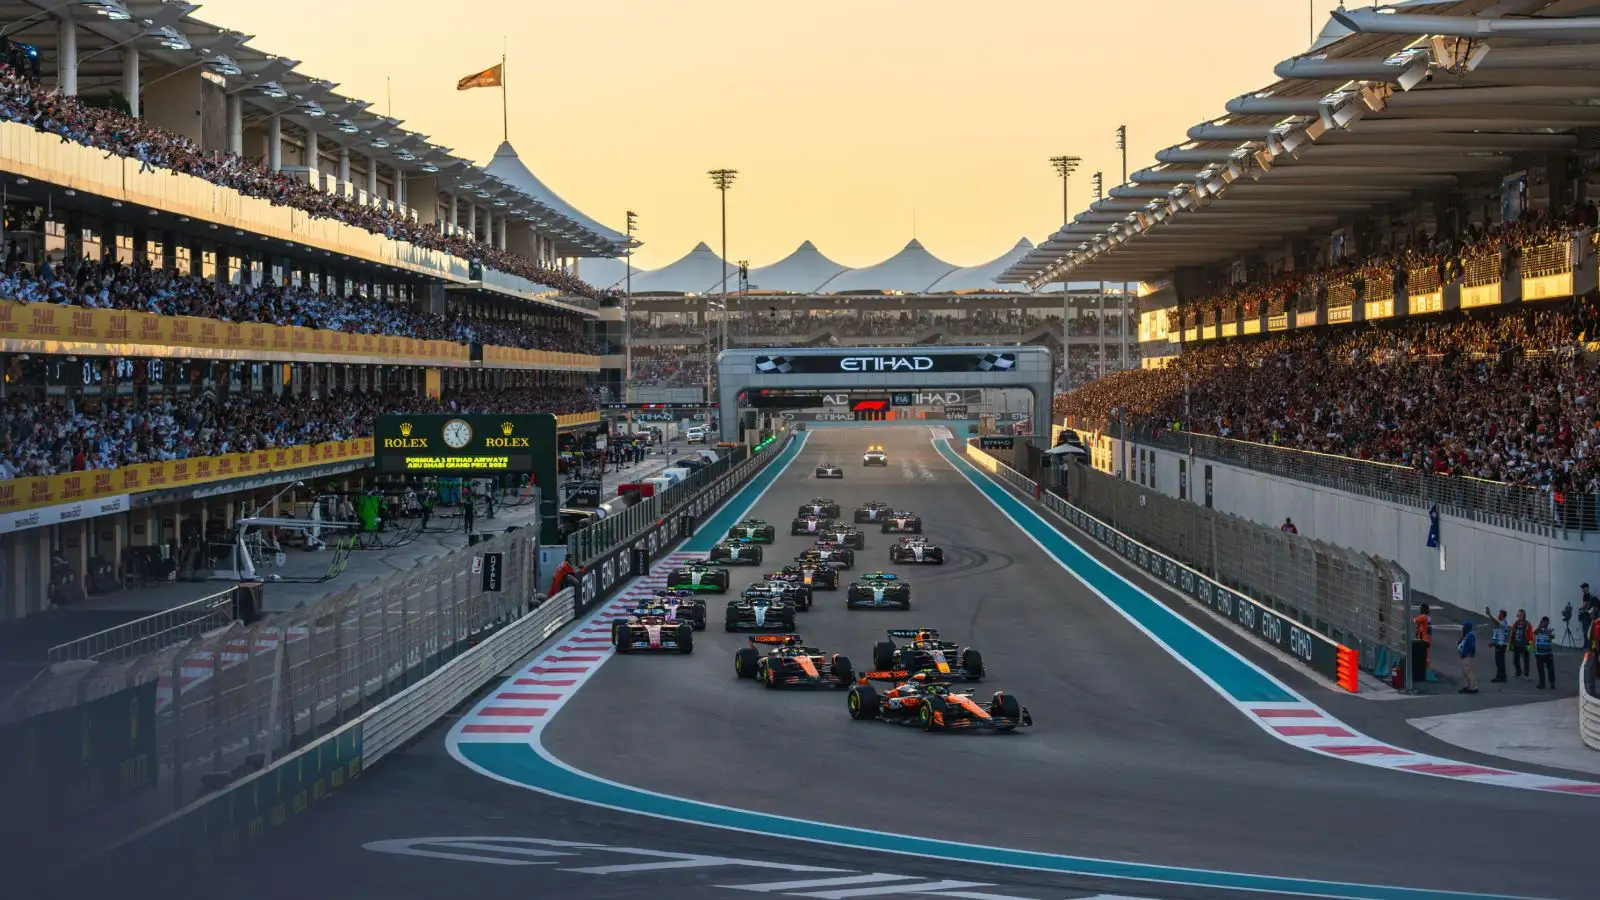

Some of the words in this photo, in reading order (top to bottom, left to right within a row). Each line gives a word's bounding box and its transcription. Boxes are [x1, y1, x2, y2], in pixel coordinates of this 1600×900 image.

[840, 356, 933, 371] ETIHAD
[894, 395, 910, 404] FIA
[384, 438, 428, 448] ROLEX
[486, 437, 530, 447] ROLEX
[582, 569, 597, 606] ETIHAD
[1199, 578, 1212, 605] ETIHAD
[1217, 588, 1232, 616] ETIHAD
[1238, 599, 1255, 629] ETIHAD
[1262, 611, 1282, 644] ETIHAD
[1290, 625, 1312, 661] ETIHAD
